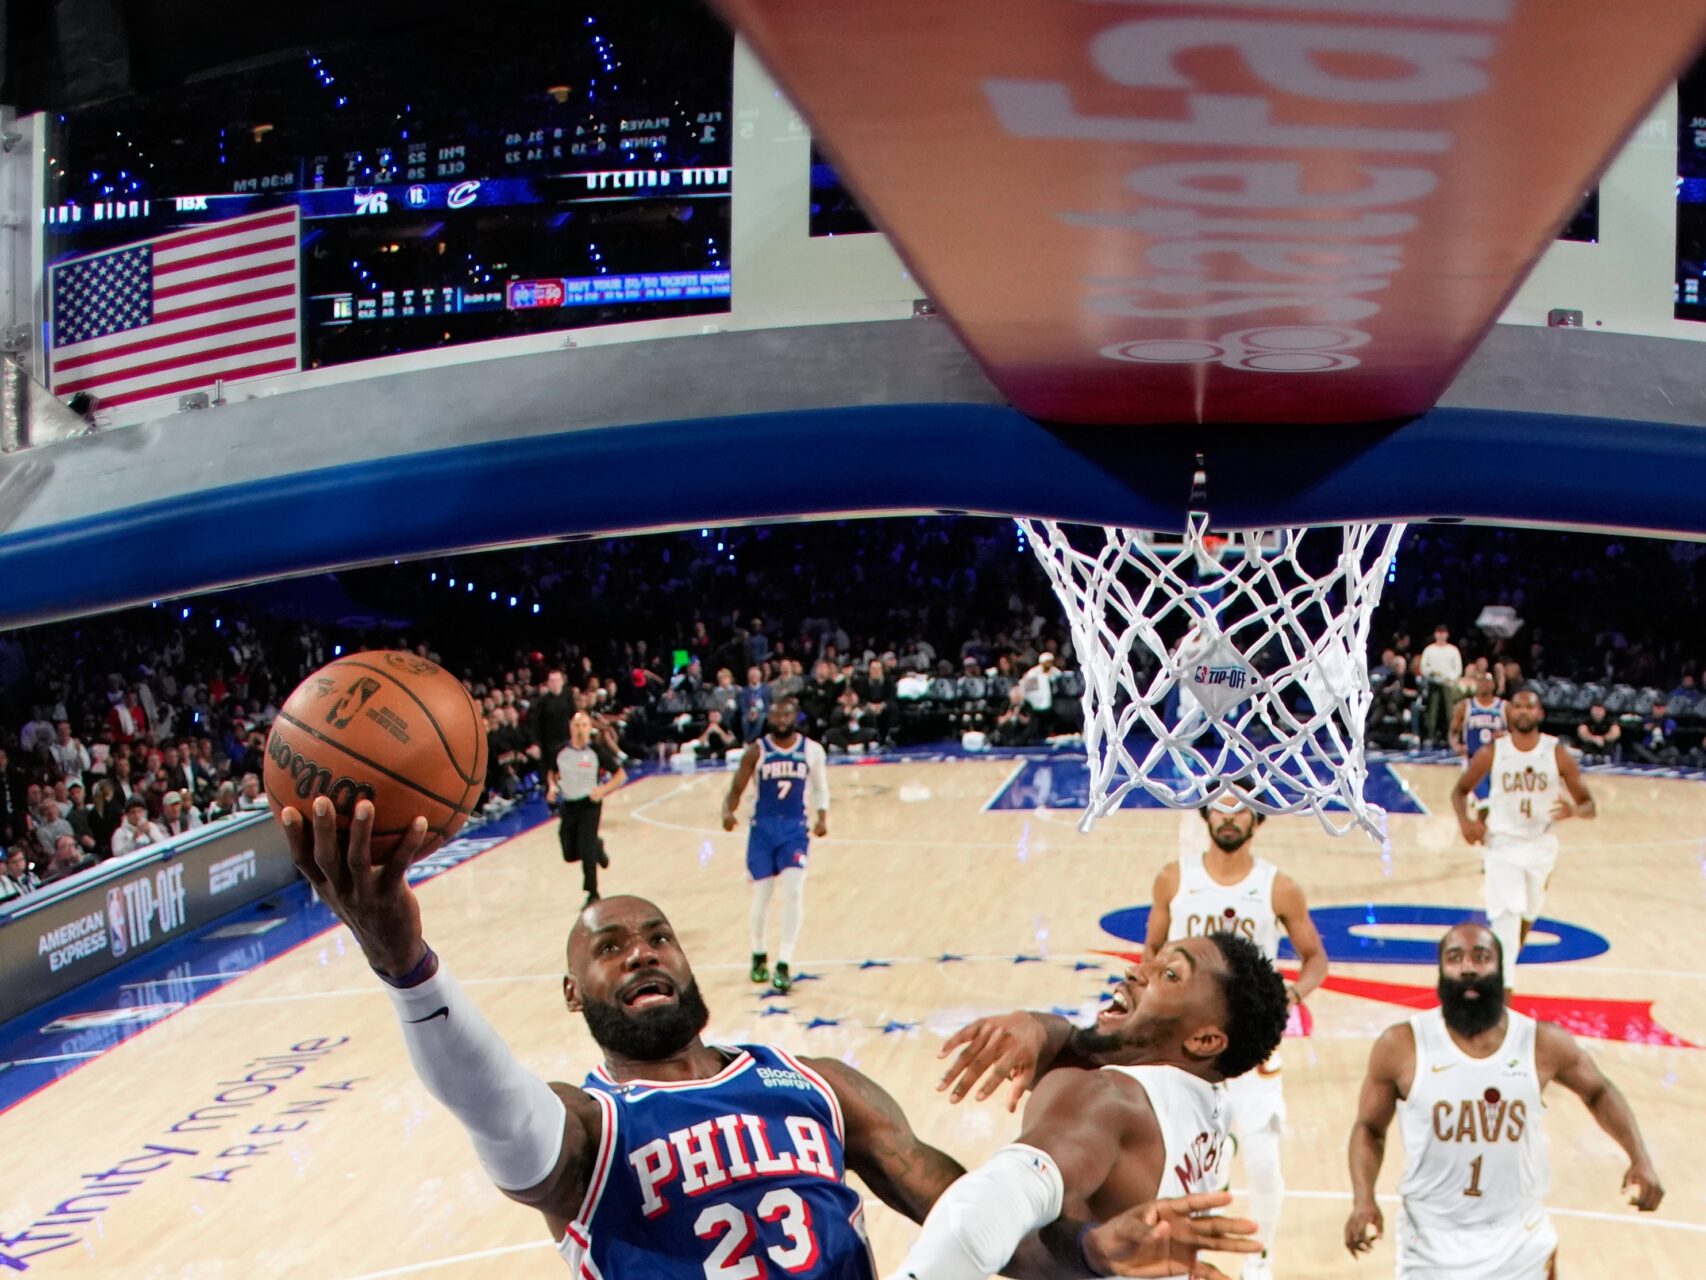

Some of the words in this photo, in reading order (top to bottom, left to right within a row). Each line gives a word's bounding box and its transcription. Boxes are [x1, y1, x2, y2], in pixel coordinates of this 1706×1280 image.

[176, 196, 208, 212] IBX
[1208, 668, 1246, 689] TIP-OFF
[762, 759, 809, 781] PHILA
[777, 781, 791, 800] 7
[1502, 770, 1548, 793] CAVS
[1519, 797, 1532, 818] 4
[209, 849, 256, 895] ESPN
[122, 862, 187, 949] TIP-OFF
[38, 911, 104, 956] AMERICAN
[50, 930, 108, 972] EXPRESS
[190, 1076, 371, 1182] ARENA
[1433, 1100, 1527, 1142] CAVS
[628, 1113, 839, 1221] PHILA
[1463, 1155, 1483, 1197] 1
